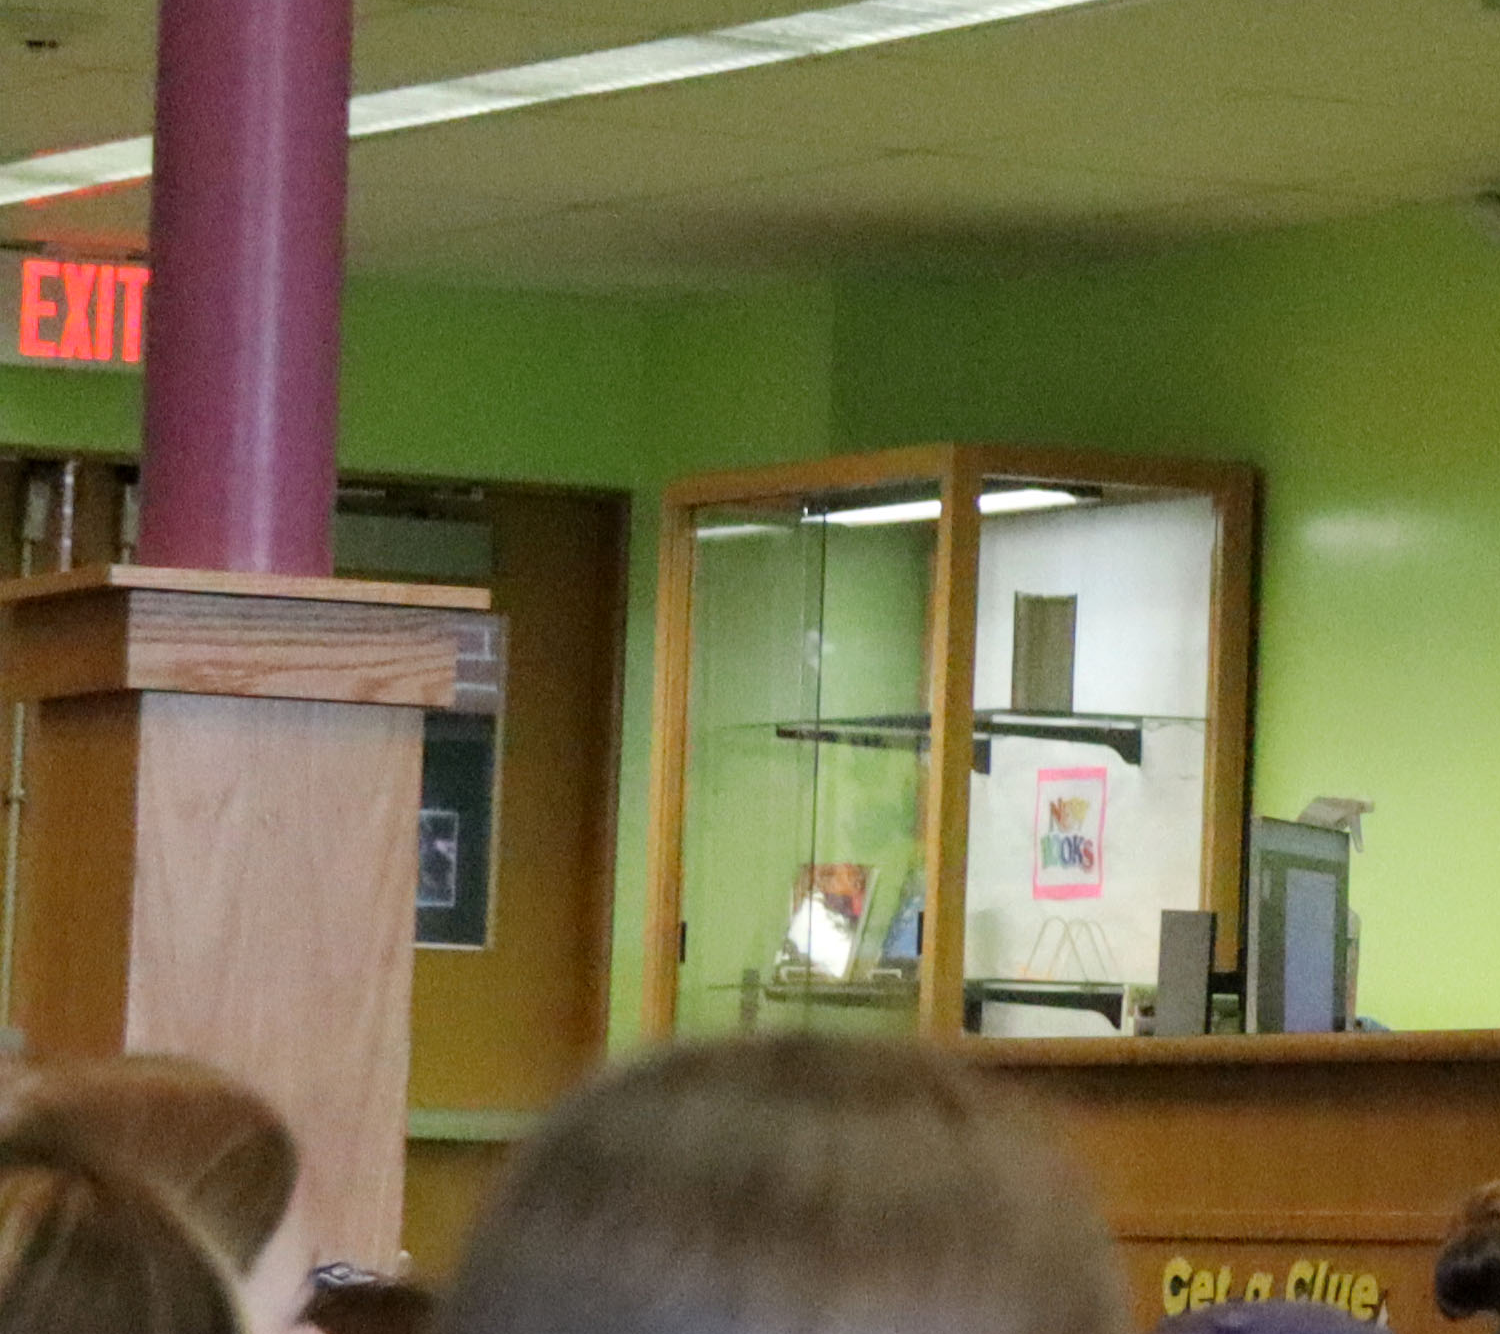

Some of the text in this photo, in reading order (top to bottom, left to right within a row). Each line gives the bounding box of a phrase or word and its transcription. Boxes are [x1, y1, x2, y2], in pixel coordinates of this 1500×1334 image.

[20, 259, 153, 364] EXIT
[1161, 1256, 1233, 1318] Get
[1284, 1259, 1380, 1322] Clue
